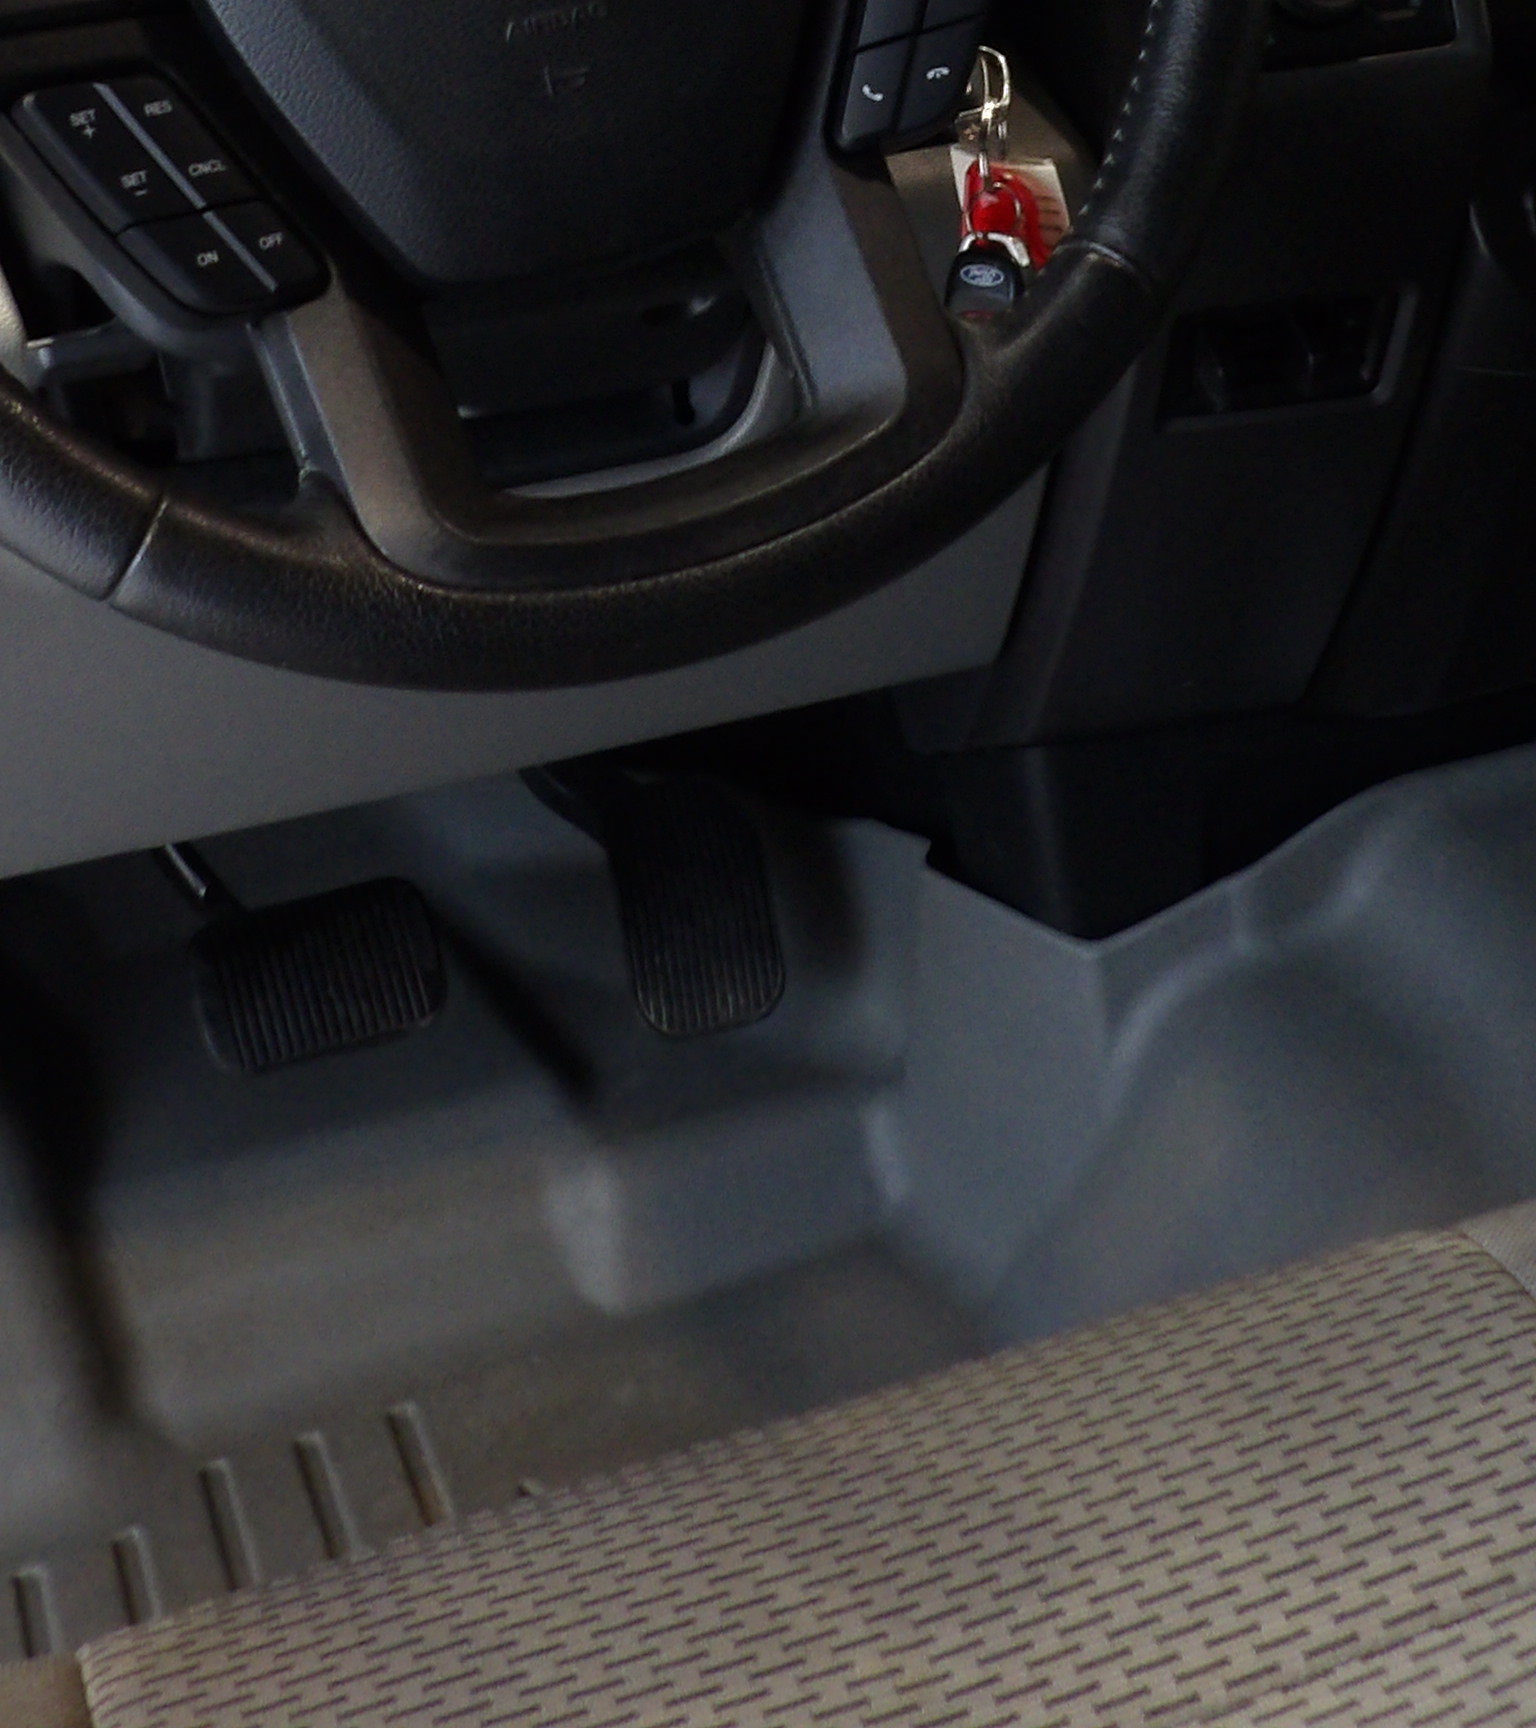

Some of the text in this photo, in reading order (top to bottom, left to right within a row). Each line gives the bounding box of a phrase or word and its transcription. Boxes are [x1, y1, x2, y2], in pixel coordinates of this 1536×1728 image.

[144, 99, 173, 117] RES
[68, 108, 97, 128] SET
[188, 159, 227, 178] CNCL
[120, 169, 148, 189] SET
[258, 232, 284, 251] OFF
[196, 250, 220, 268] ON
